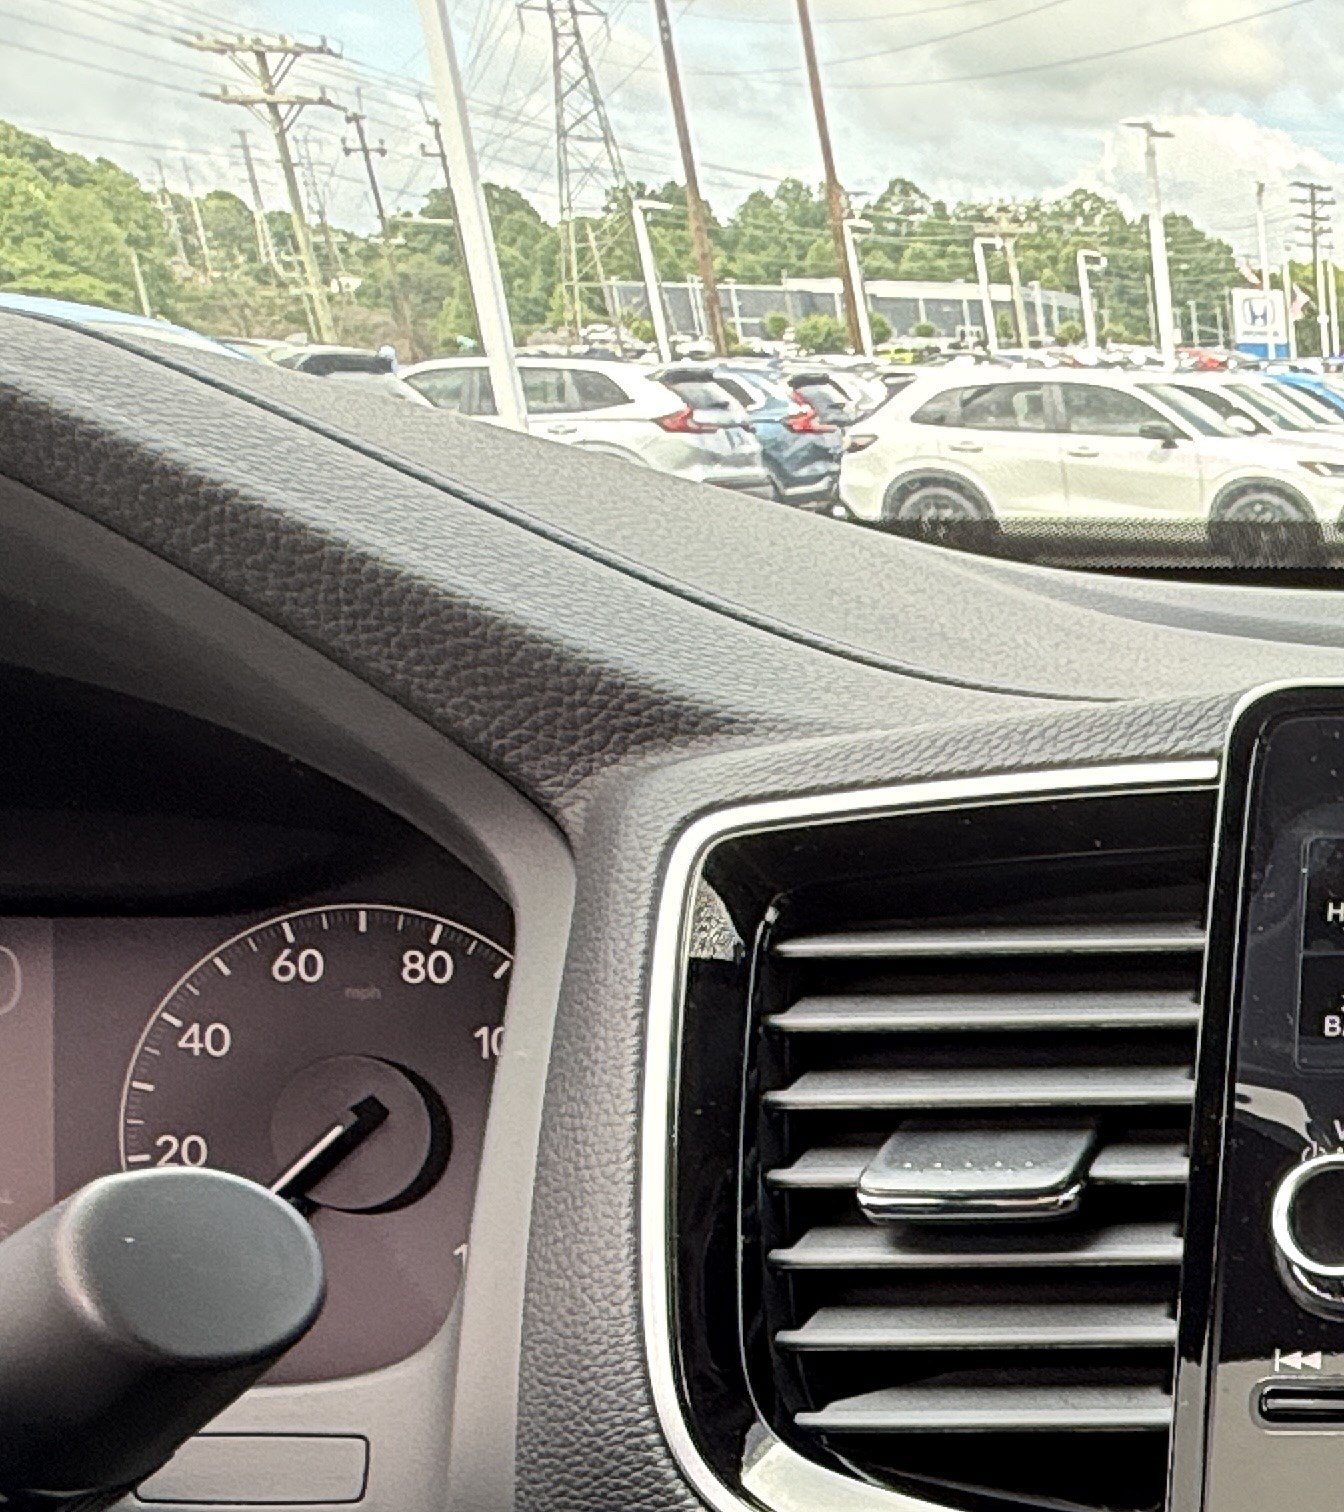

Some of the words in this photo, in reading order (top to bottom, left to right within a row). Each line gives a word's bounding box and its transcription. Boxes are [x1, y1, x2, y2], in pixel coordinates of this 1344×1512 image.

[271, 948, 325, 983] 60
[401, 949, 454, 984] 80
[178, 1023, 231, 1057] 40
[155, 1134, 208, 1167] 20
